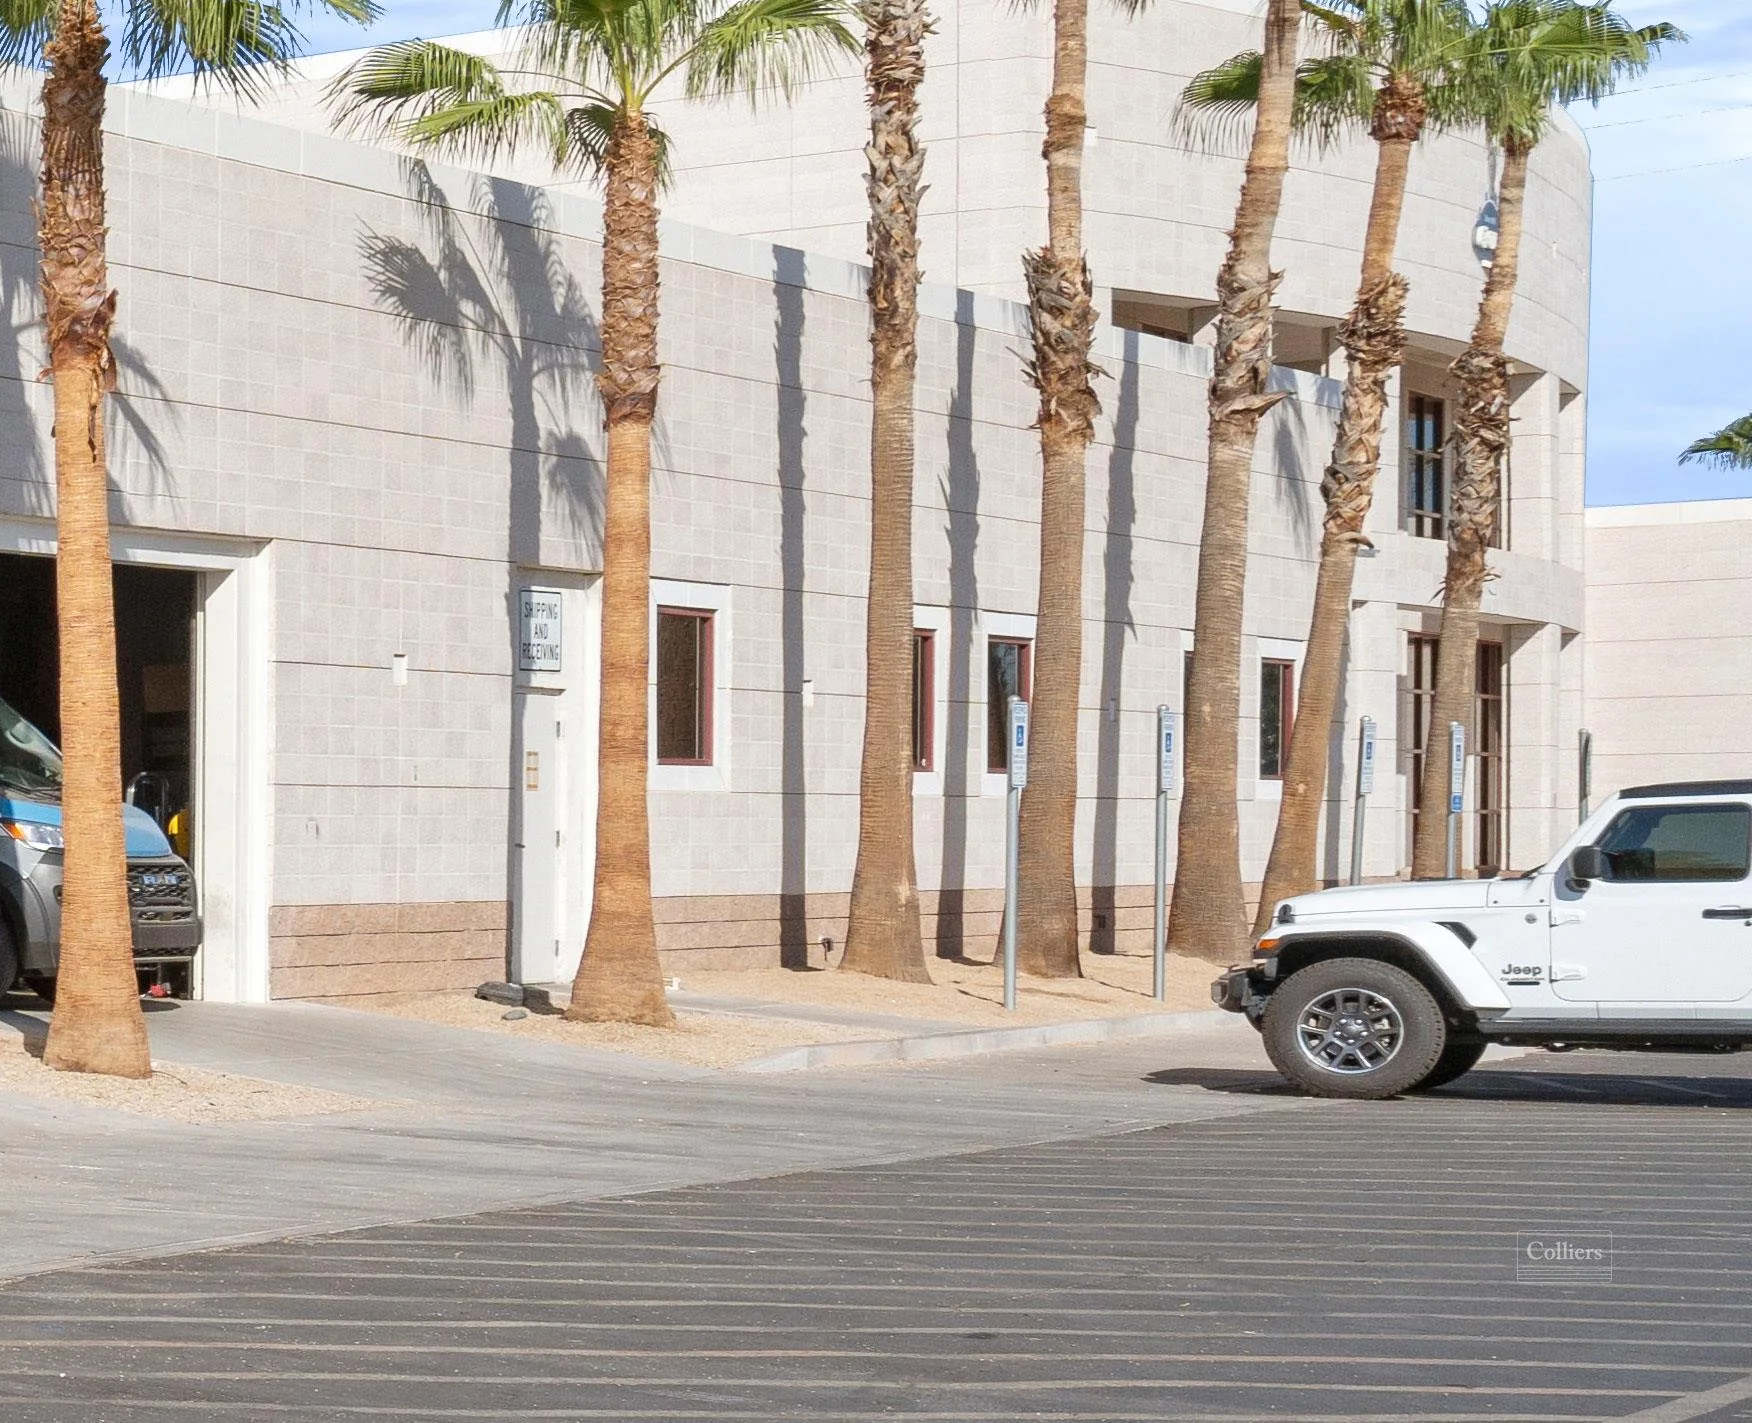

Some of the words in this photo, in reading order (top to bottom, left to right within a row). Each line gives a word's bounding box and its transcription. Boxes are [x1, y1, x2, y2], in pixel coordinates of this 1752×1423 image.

[524, 602, 558, 620] SHIPPING
[533, 623, 549, 640] AND
[522, 642, 559, 661] RECEIVING
[1501, 963, 1543, 977] Jeep
